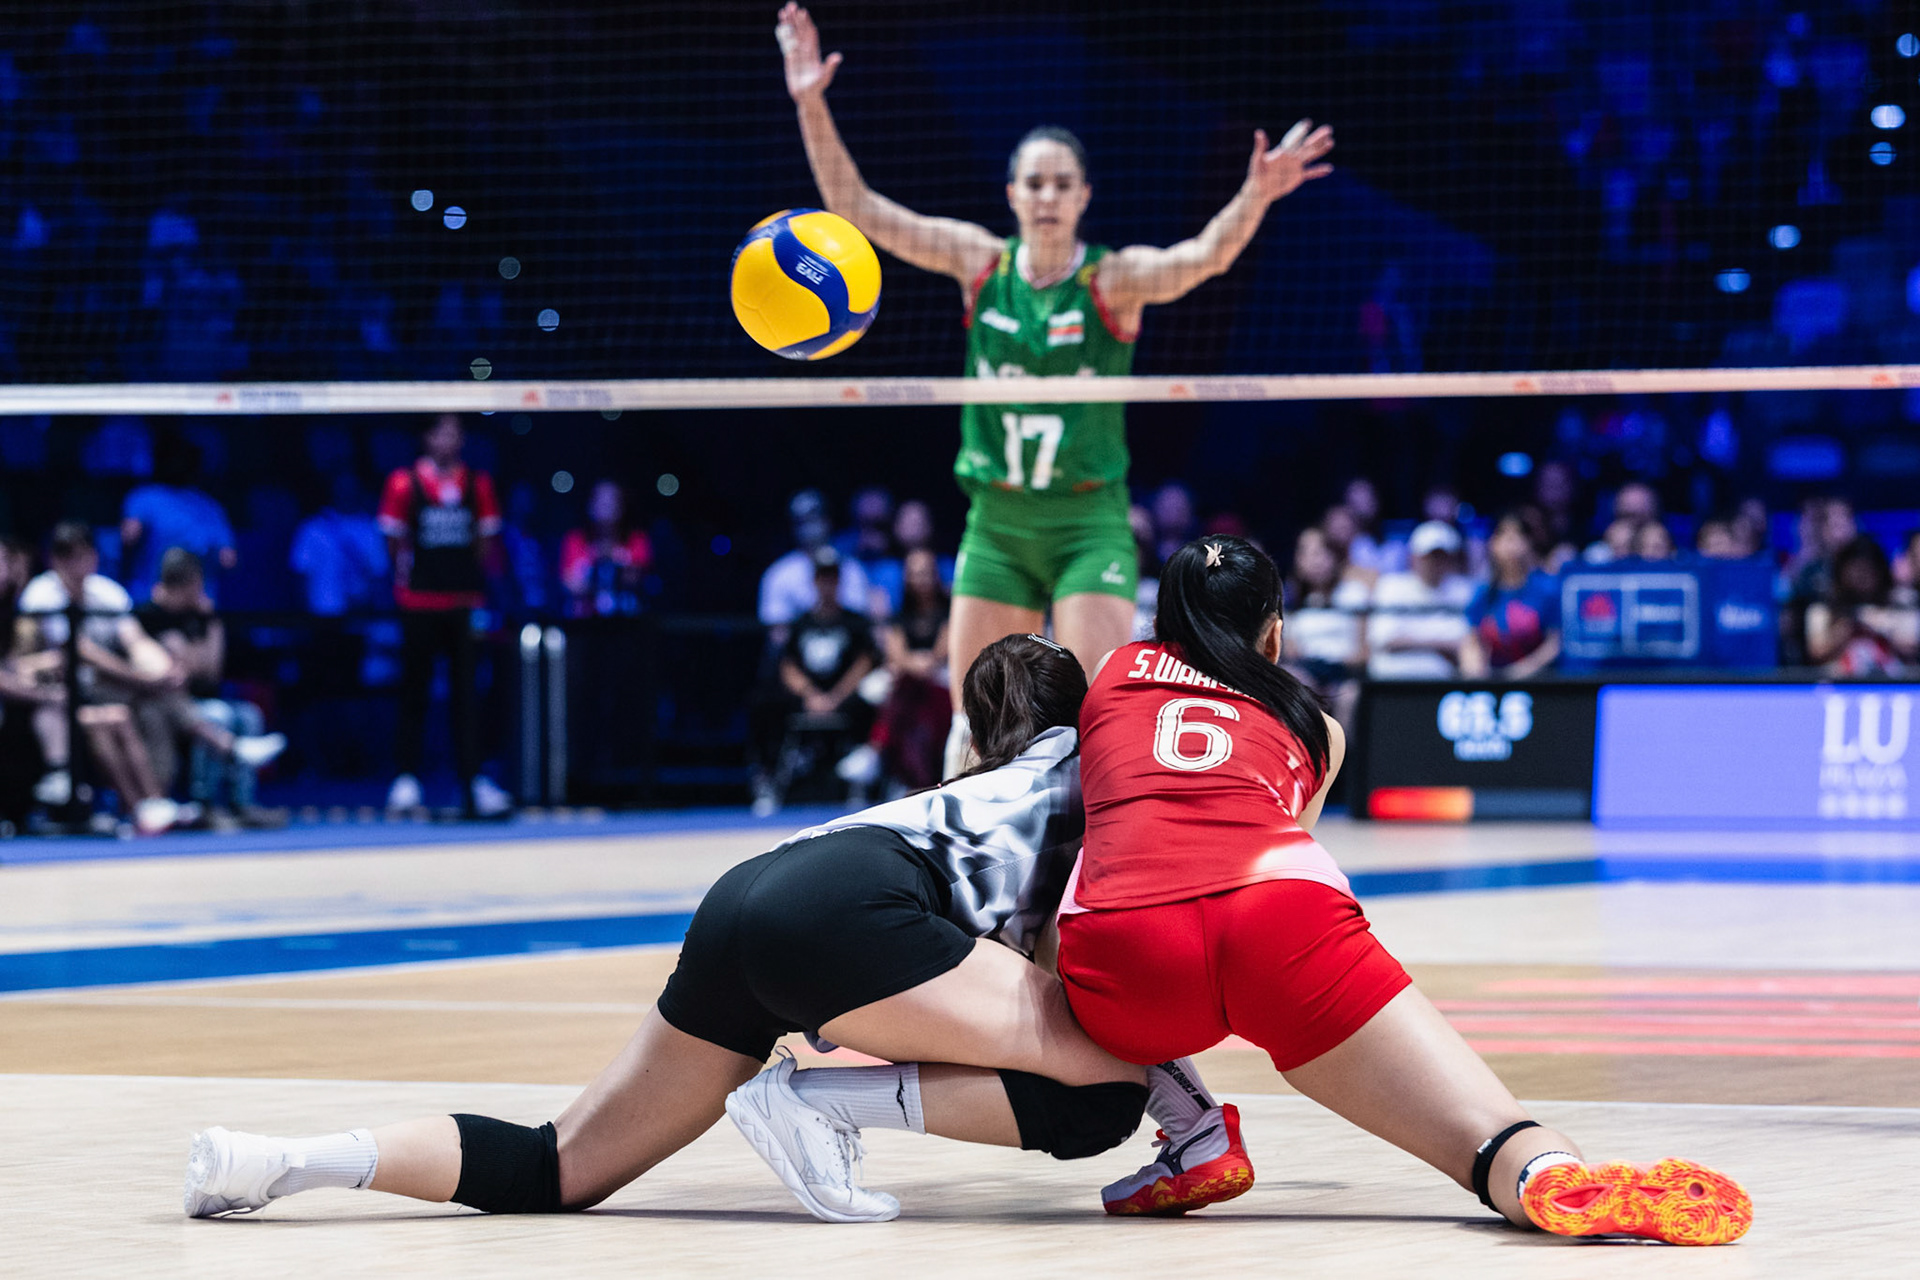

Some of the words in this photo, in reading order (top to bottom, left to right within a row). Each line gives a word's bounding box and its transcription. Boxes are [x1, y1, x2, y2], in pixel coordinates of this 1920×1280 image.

[1001, 411, 1064, 490] 17
[1152, 697, 1240, 772] 6
[1823, 693, 1911, 764] LU
